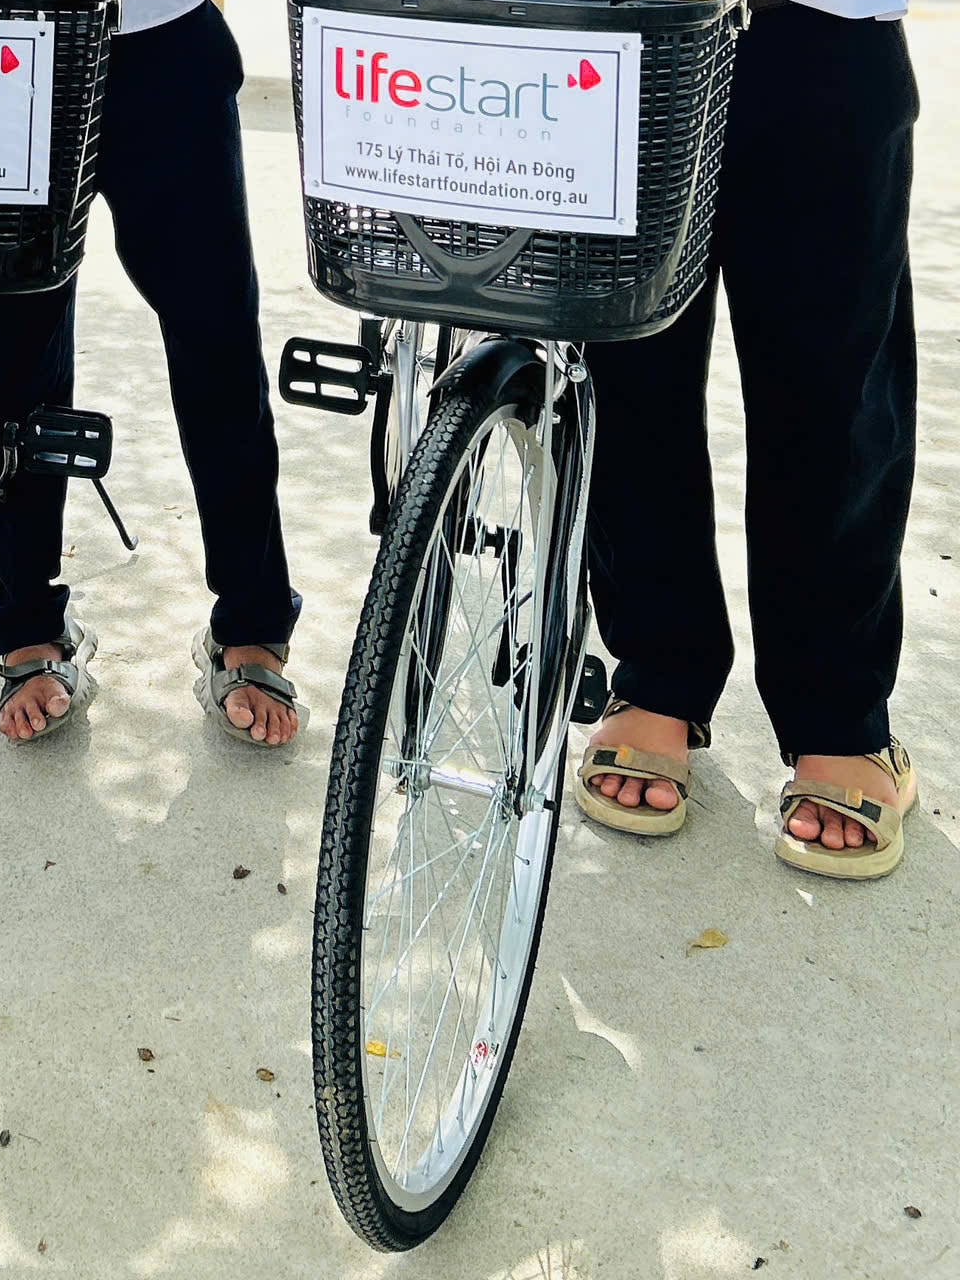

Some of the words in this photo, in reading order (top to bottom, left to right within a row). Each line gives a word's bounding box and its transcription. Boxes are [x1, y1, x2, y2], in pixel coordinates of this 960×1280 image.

[335, 47, 559, 121] lifestart
[346, 104, 551, 142] foundation
[356, 141, 382, 158] 175
[388, 144, 403, 165] Lý
[408, 148, 440, 167] Thái
[474, 156, 501, 176] Hội
[506, 159, 528, 176] An
[532, 161, 575, 182] Đông
[346, 163, 588, 205] www.lifestartfoundation.org.au
